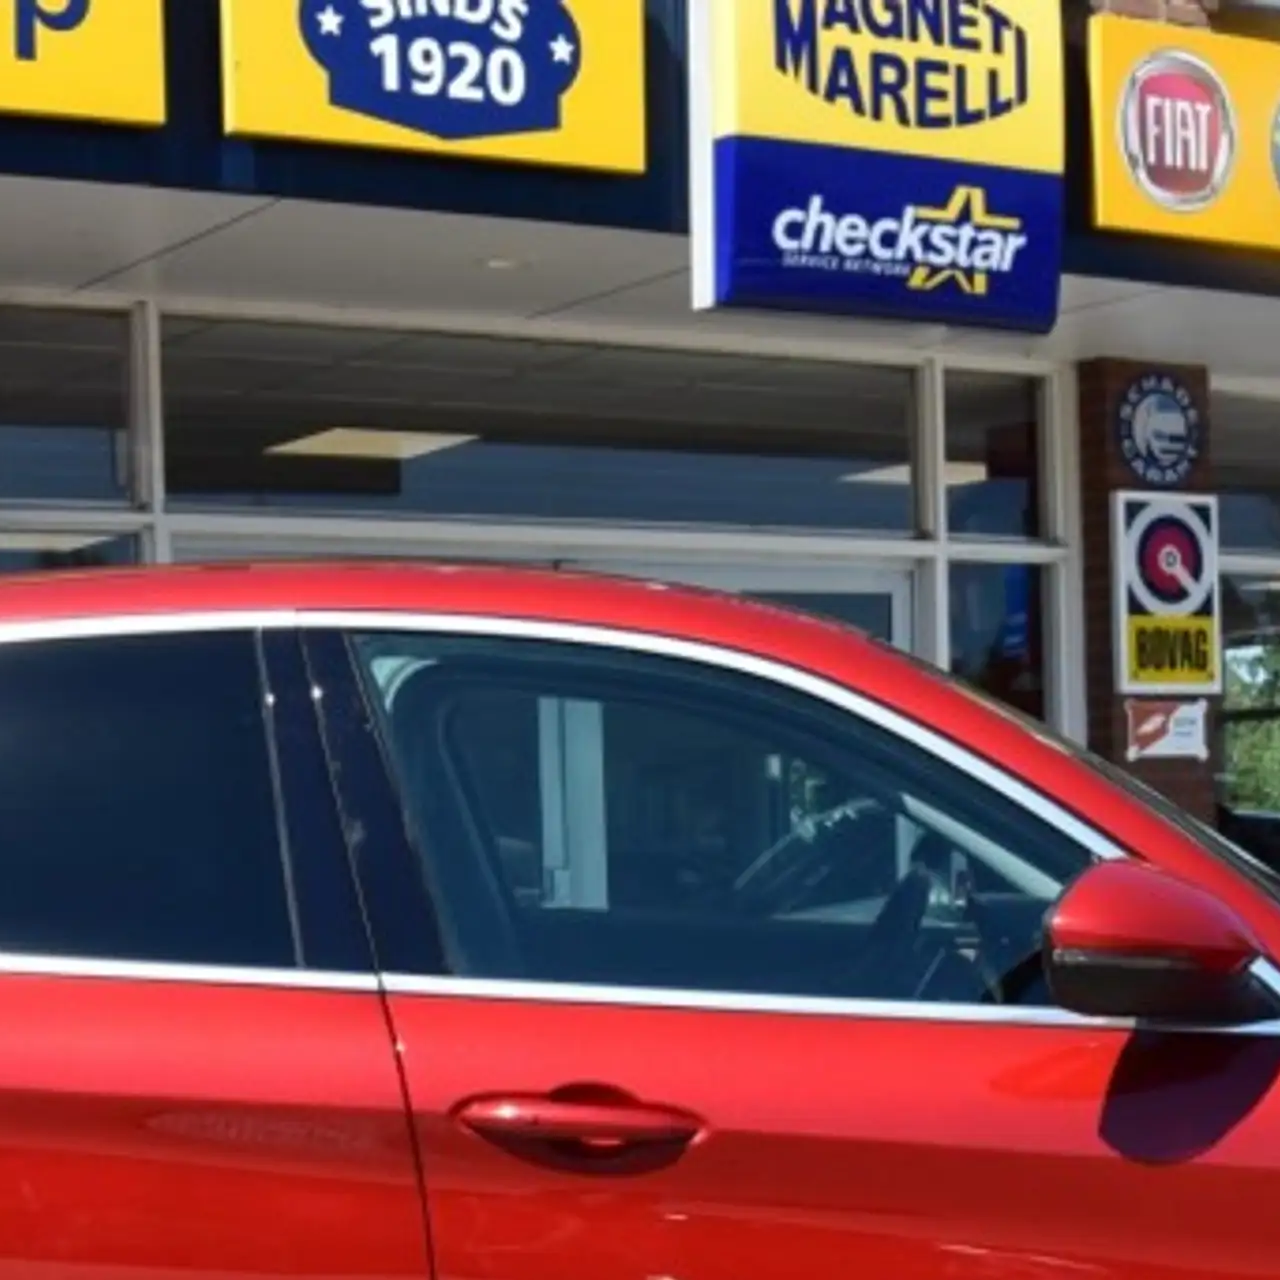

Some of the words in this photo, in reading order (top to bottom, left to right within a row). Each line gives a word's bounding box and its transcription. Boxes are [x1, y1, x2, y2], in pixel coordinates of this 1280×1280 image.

[369, 33, 526, 106] 1920
[1146, 94, 1211, 172] FIAT
[772, 193, 1027, 273] checkstar
[1136, 625, 1208, 672] BOVAG
